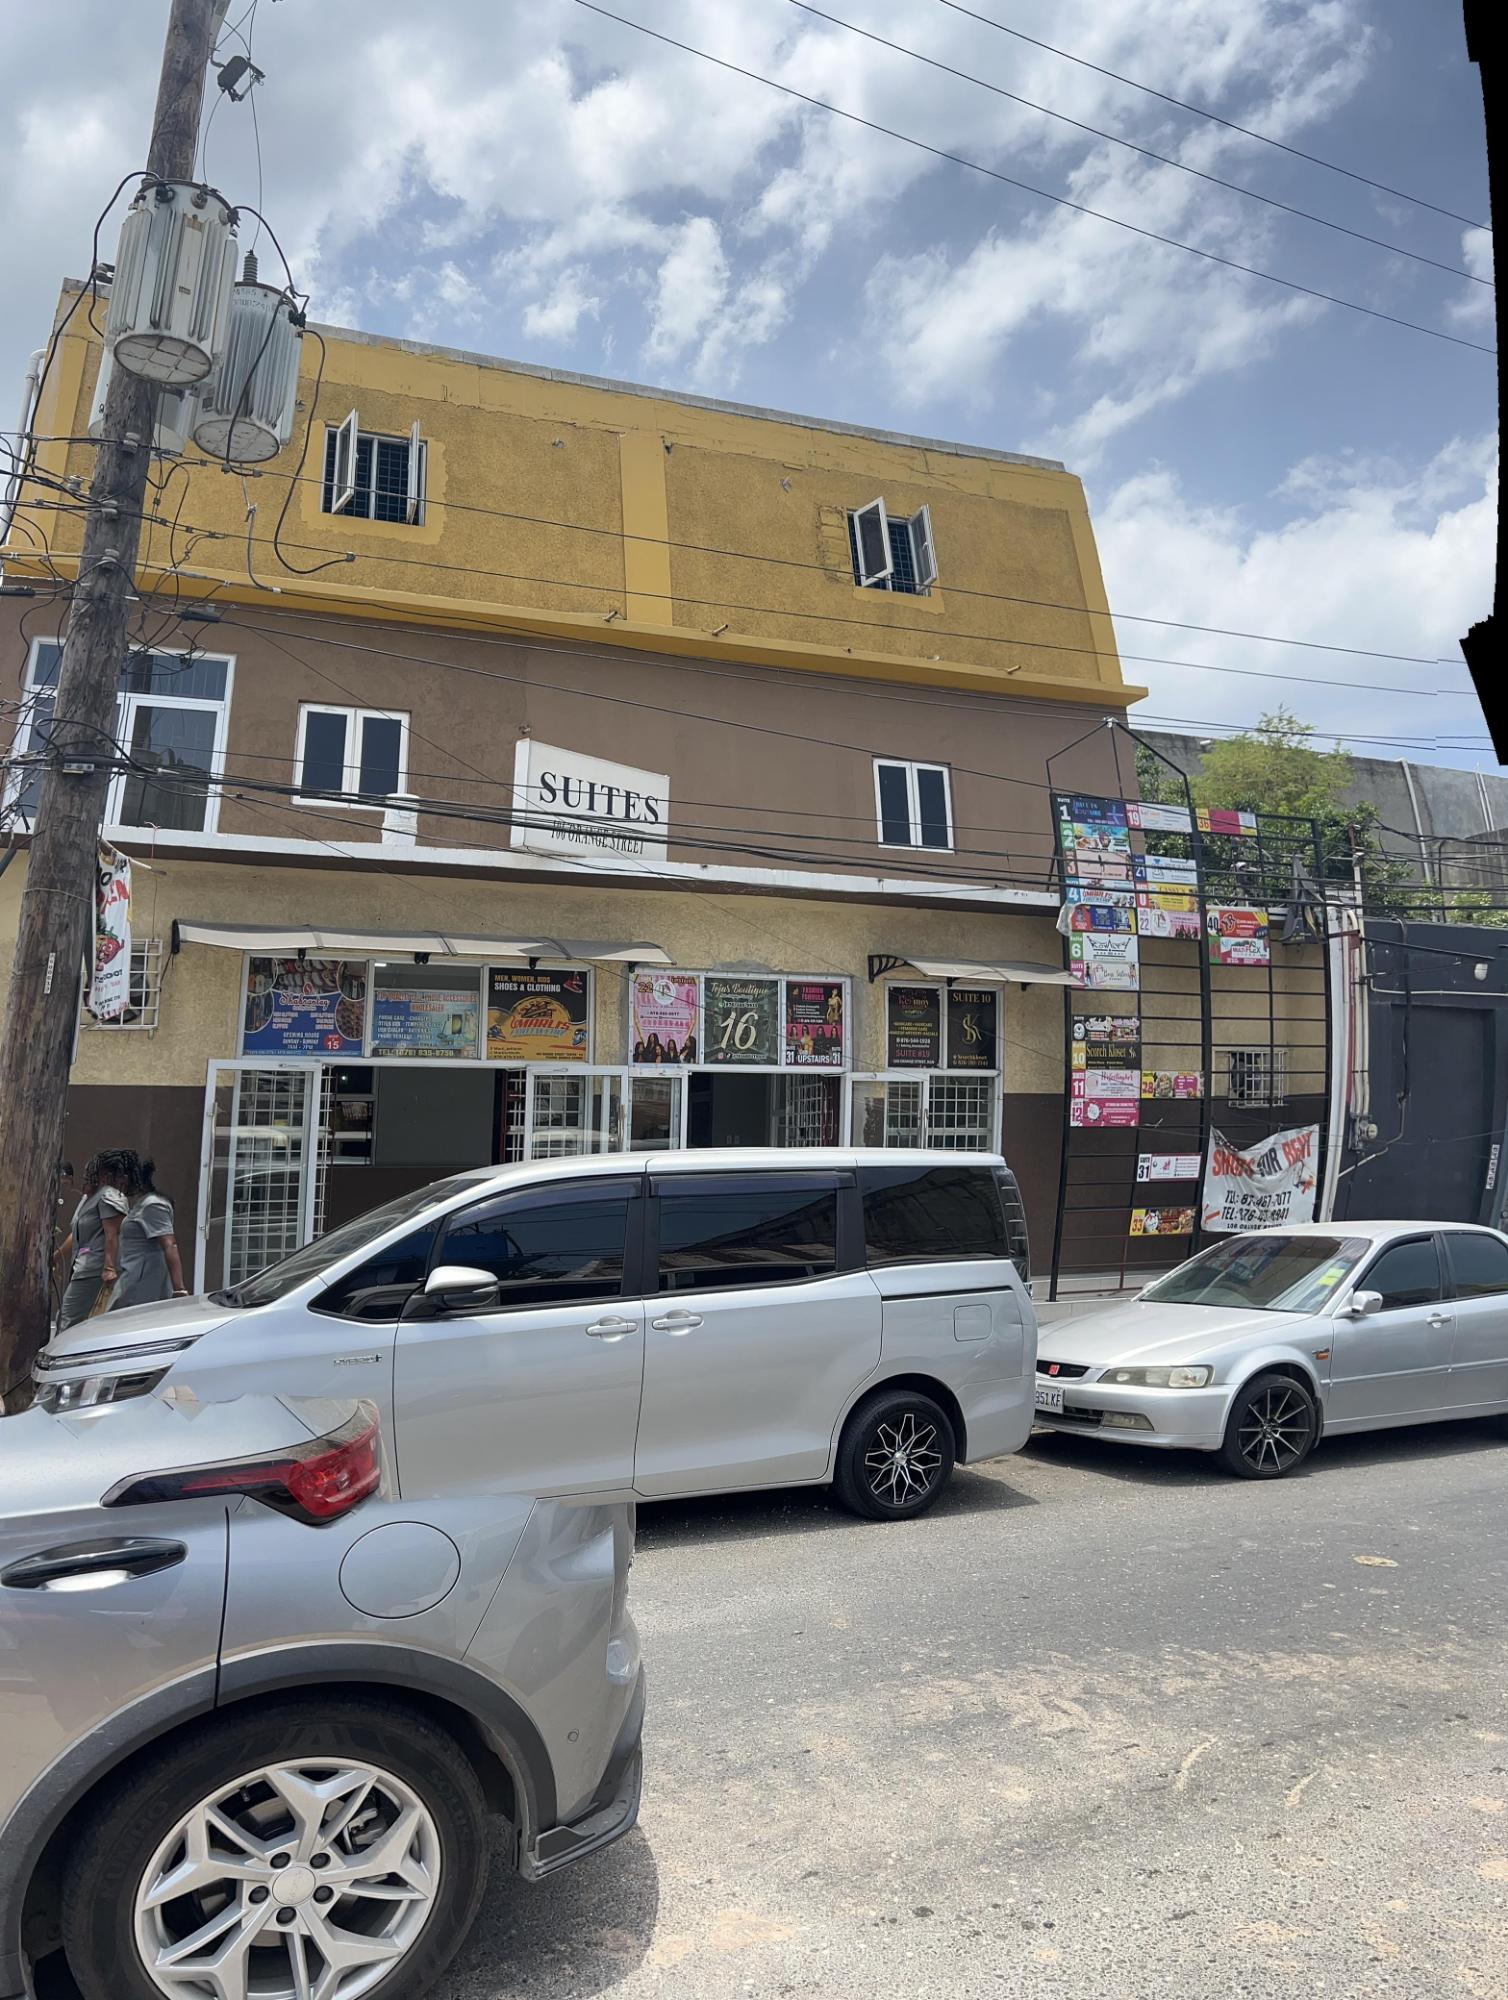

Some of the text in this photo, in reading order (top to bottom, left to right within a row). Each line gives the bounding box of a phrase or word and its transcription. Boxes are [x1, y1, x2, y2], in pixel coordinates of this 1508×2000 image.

[540, 771, 658, 826] SUITES
[1059, 805, 1071, 820] 1
[1128, 811, 1139, 826] 19
[1199, 818, 1209, 830] 36
[1063, 829, 1074, 847] 2
[1136, 866, 1146, 877] 21
[1069, 887, 1079, 902] 4
[1139, 918, 1149, 931] 22
[1207, 917, 1219, 931] 40
[1071, 943, 1081, 958] 6
[511, 975, 537, 984] WOMEN,
[494, 982, 518, 991] SHOES
[527, 984, 561, 992] CLOTHING
[638, 982, 654, 993] 22
[953, 992, 991, 1003] SUITE 10
[720, 1010, 759, 1050] 16
[1073, 1022, 1085, 1040] 9
[327, 1041, 339, 1050] 15
[786, 1050, 841, 1065] 31 UPSTAIRS 31
[1073, 1052, 1085, 1064] 10
[1073, 1080, 1084, 1096] 11
[1142, 1081, 1154, 1094] 28
[1072, 1107, 1082, 1122] 12
[1138, 1164, 1150, 1179] 31
[1221, 1206, 1238, 1220] TEL:
[1132, 1219, 1143, 1232] 33
